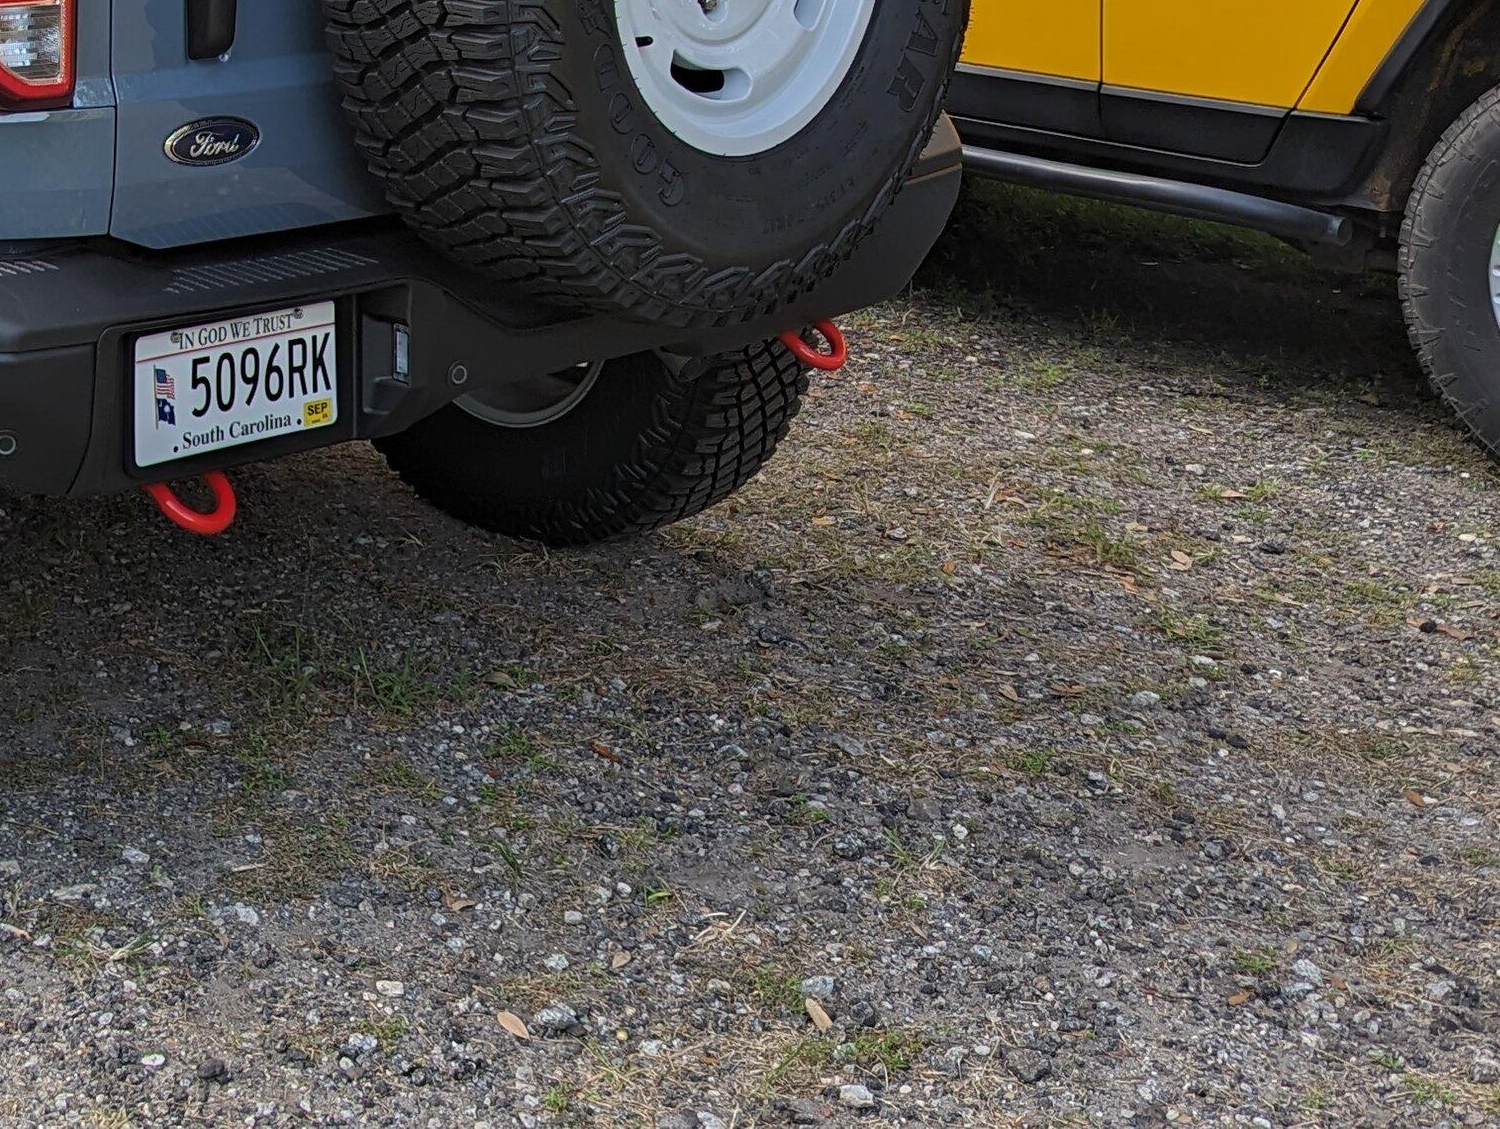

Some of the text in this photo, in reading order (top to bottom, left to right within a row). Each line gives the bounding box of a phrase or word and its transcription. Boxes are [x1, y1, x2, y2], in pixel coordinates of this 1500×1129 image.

[189, 130, 240, 158] Ford
[178, 315, 293, 349] IN GOD WE TRUST
[191, 332, 332, 418] 5096RK
[307, 402, 328, 416] SEP
[182, 413, 292, 450] South Carolina
